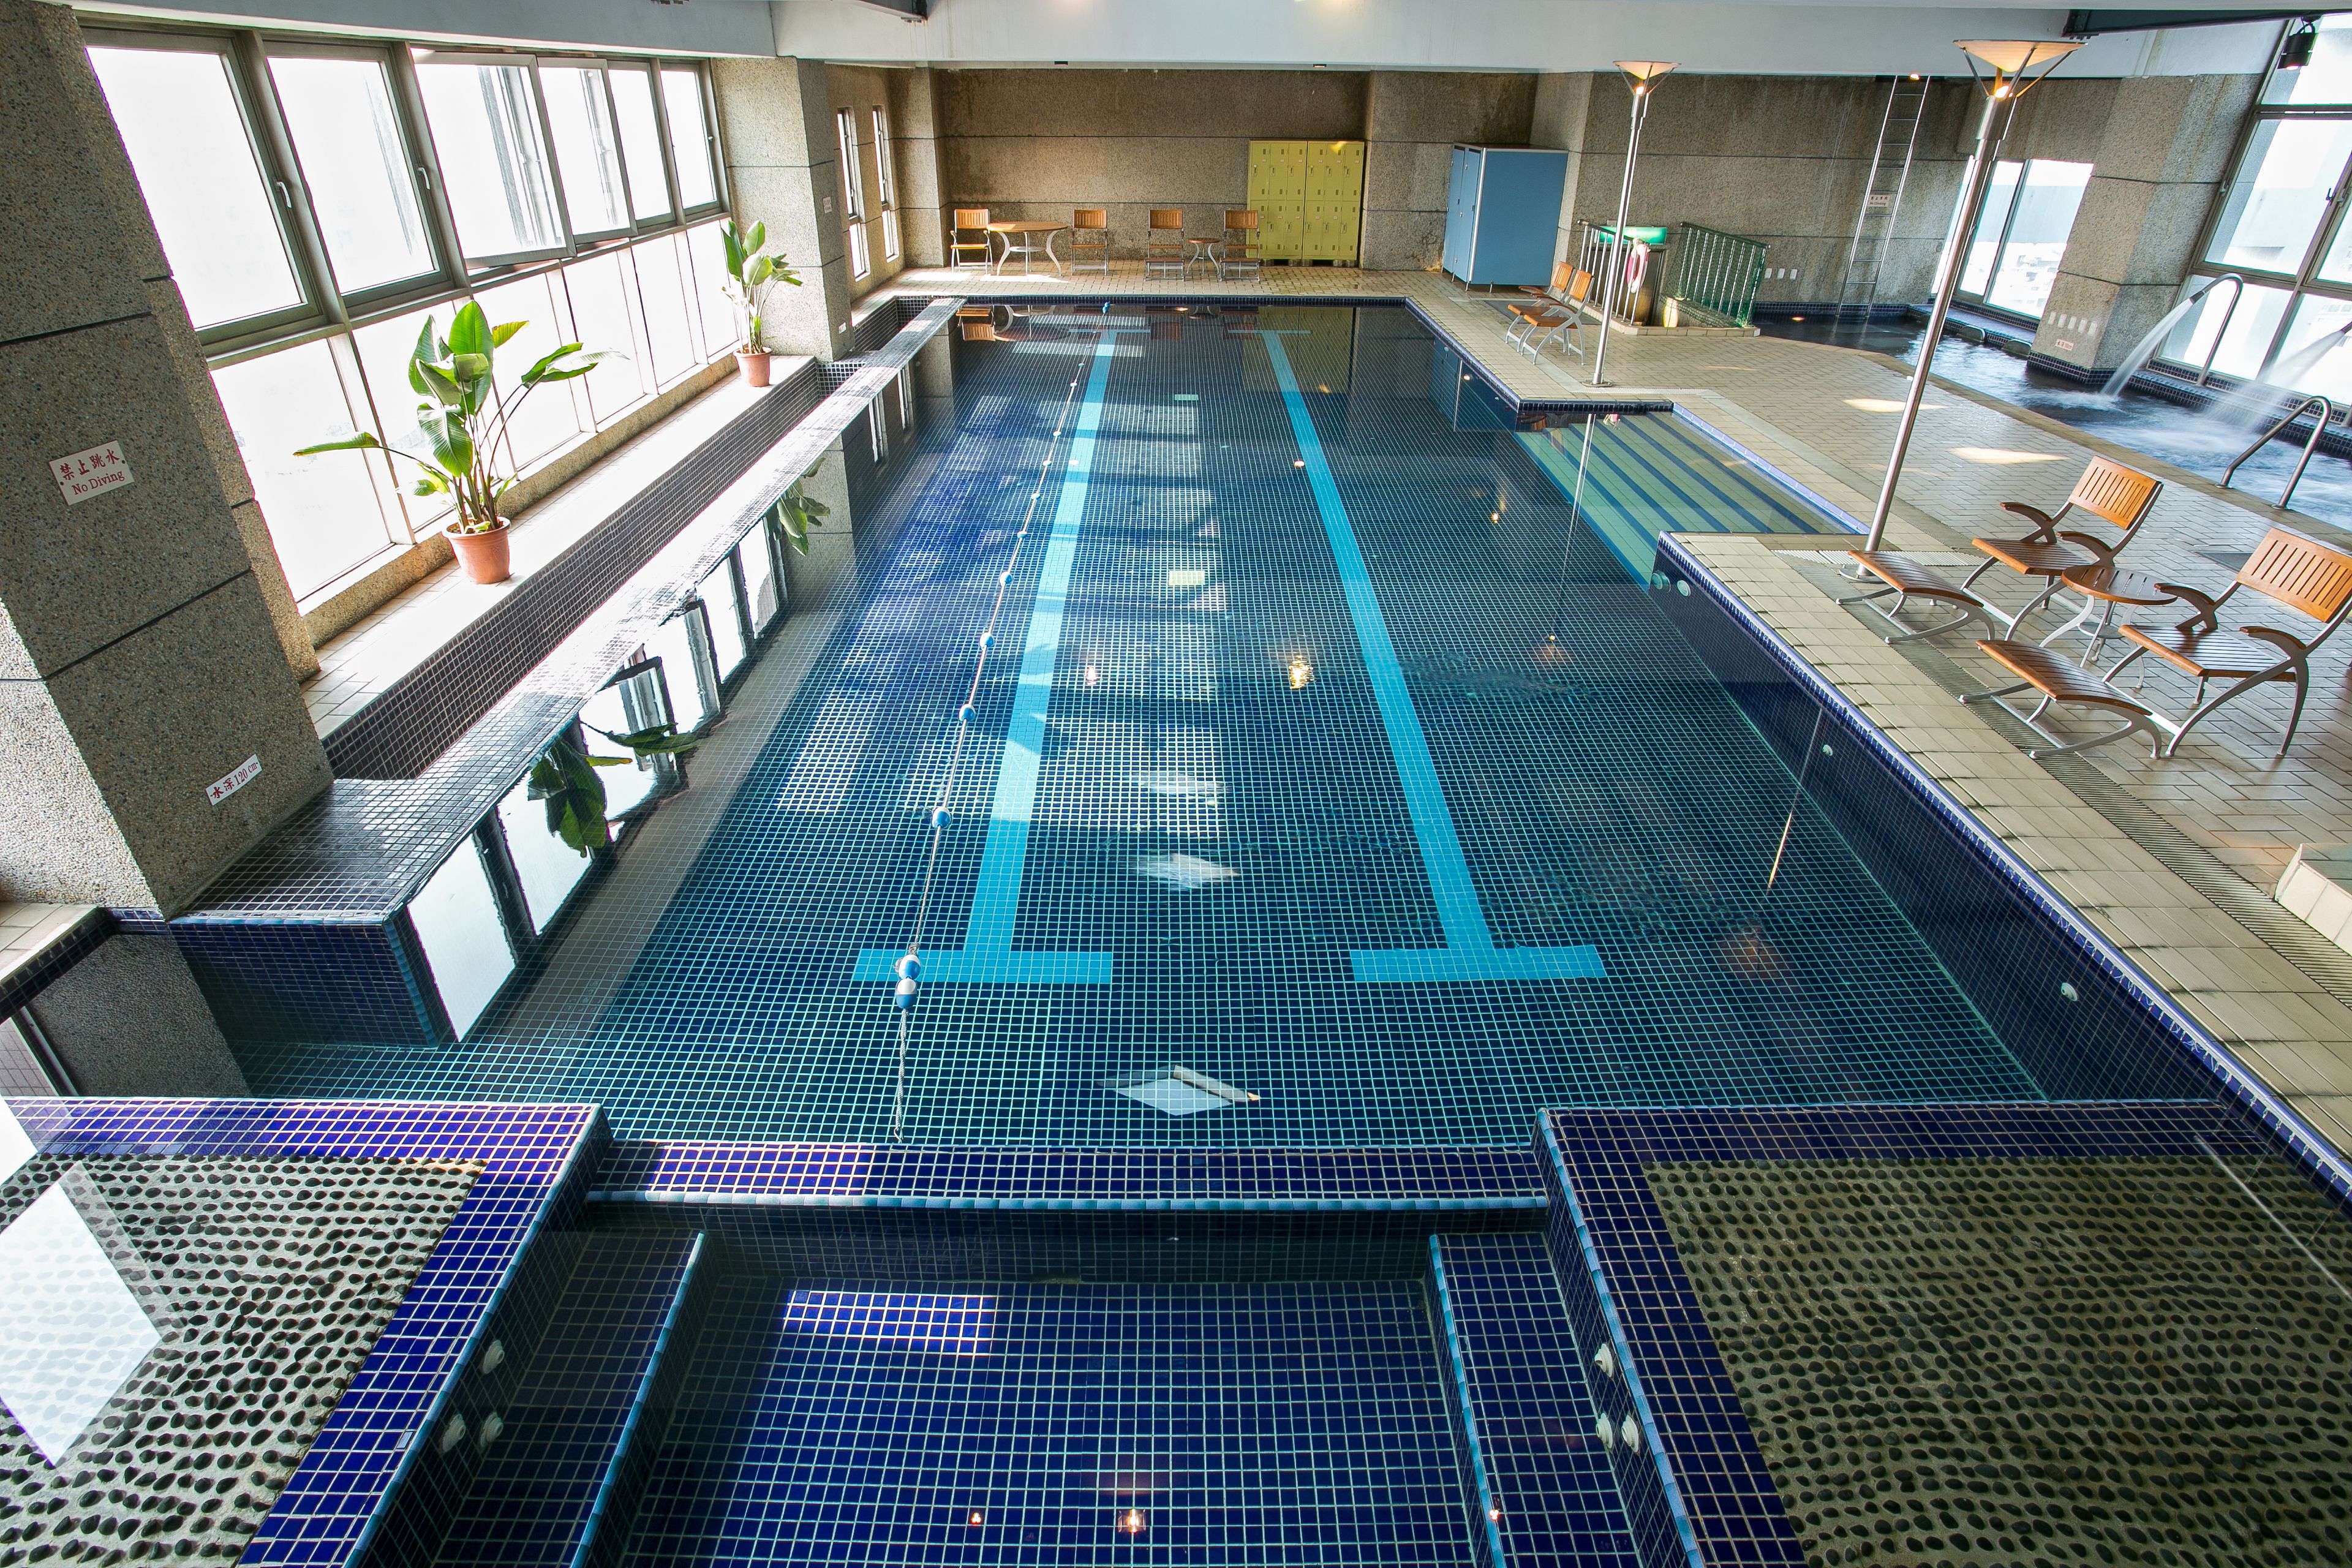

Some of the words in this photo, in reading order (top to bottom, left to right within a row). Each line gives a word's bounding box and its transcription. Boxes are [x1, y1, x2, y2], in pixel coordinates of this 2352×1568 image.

[60, 449, 119, 481] 禁止跳水
[71, 483, 88, 496] No
[88, 471, 125, 489] Diving
[213, 778, 235, 799] 水深
[234, 768, 248, 786] 120
[247, 763, 257, 773] cm
